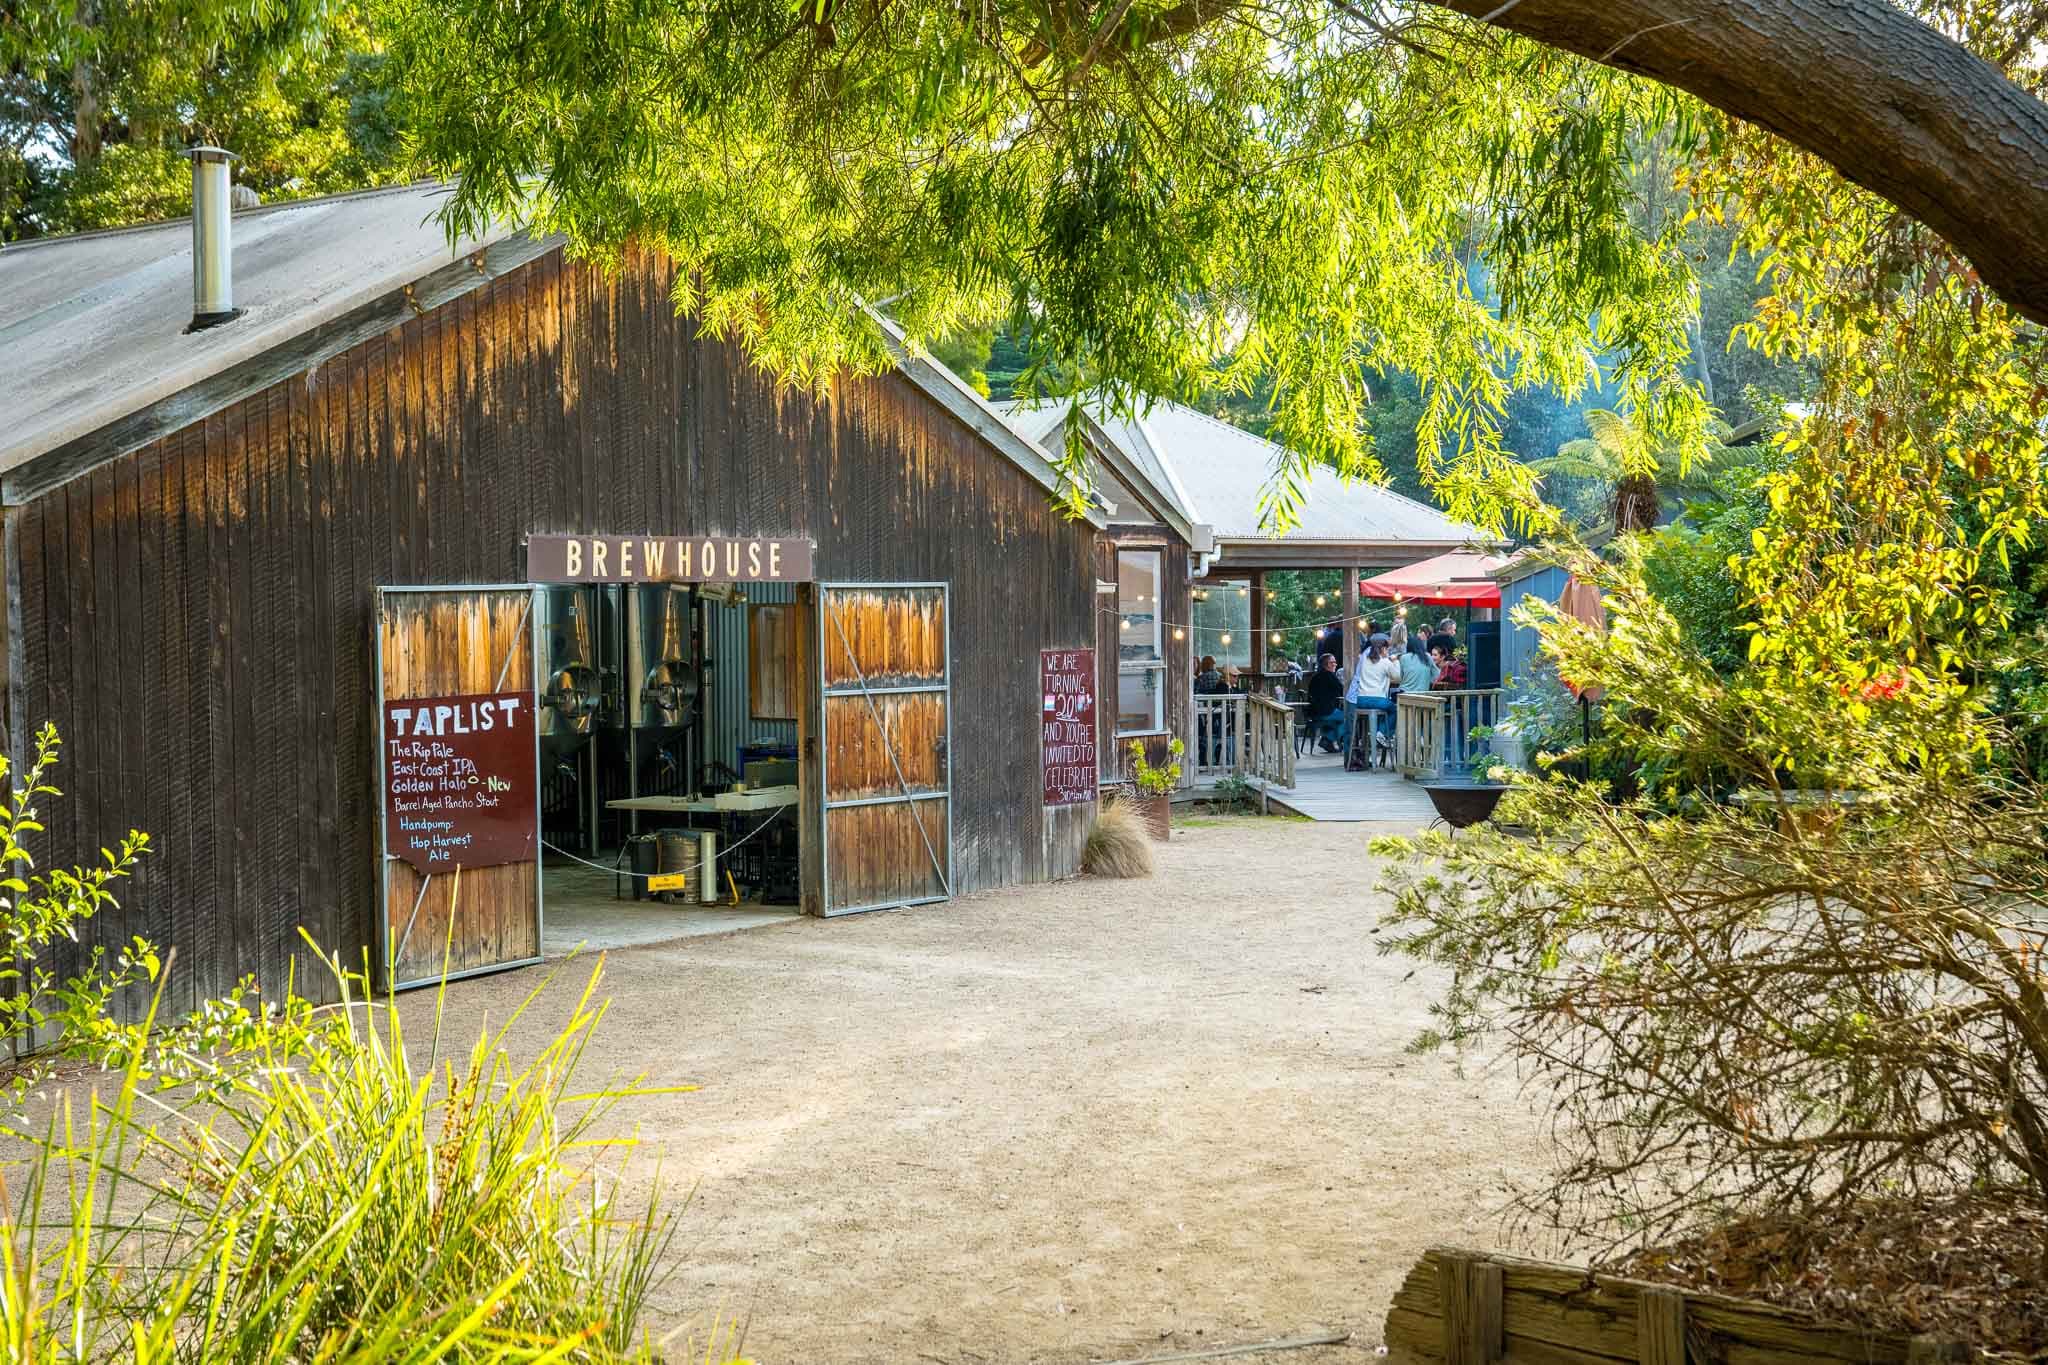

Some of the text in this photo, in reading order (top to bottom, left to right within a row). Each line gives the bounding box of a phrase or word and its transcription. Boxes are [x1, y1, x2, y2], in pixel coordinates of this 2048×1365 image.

[566, 540, 781, 577] BREWHOUSE
[1047, 653, 1080, 672] WE ARE
[1044, 673, 1086, 694] TURNING
[391, 698, 519, 736] TAPLIST
[1044, 722, 1062, 743] AND
[389, 740, 454, 762] The Rip Pale
[1045, 744, 1094, 766] INVITED TO
[391, 758, 478, 777] East Coast IPA
[439, 775, 466, 791] Halo
[1045, 766, 1096, 791] CELEBRATE
[395, 792, 500, 814] Barrel Aged Pancho Stout
[410, 832, 472, 849] Hop Harvest
[429, 849, 450, 862] Ale
